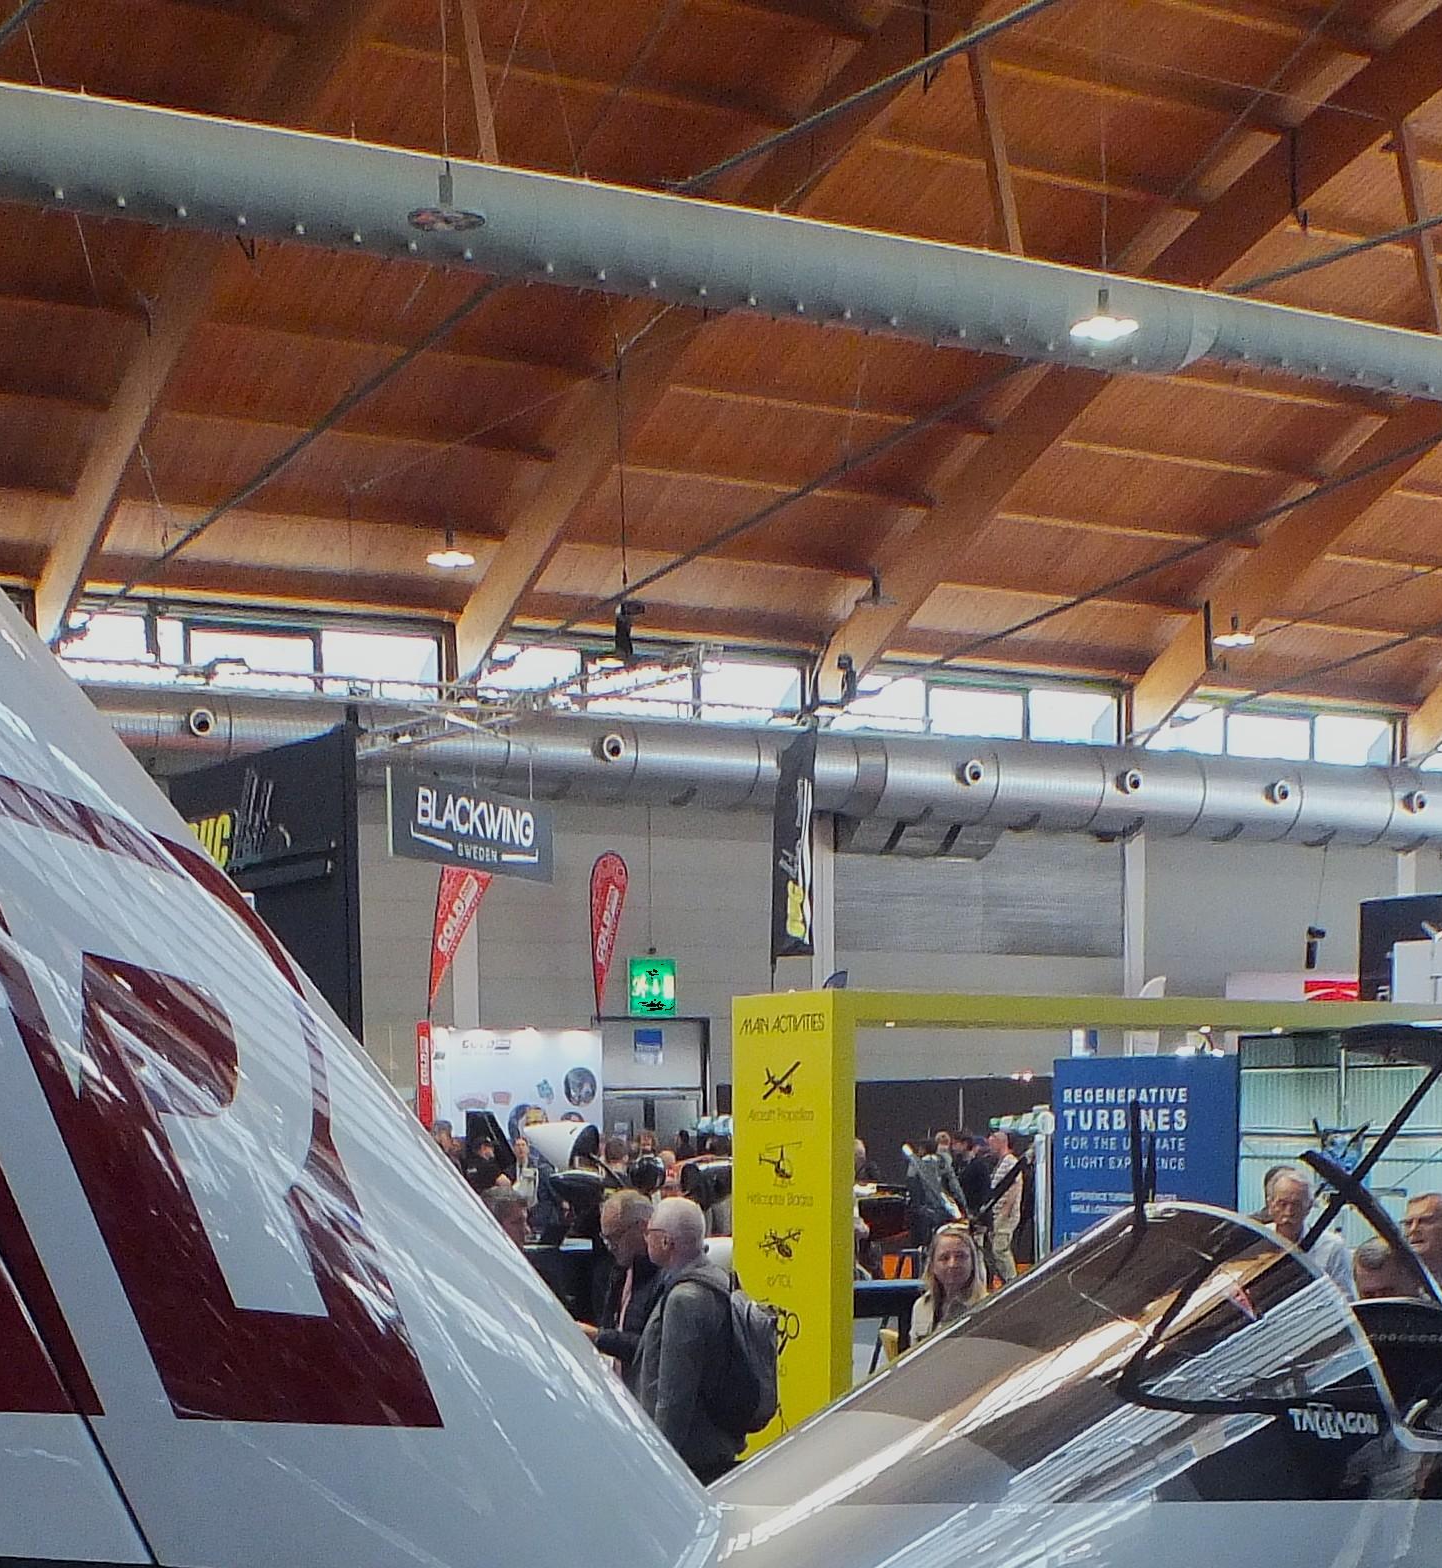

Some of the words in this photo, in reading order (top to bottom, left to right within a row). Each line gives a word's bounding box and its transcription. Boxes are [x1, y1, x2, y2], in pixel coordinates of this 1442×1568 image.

[417, 786, 535, 847] BLACKWING
[189, 812, 232, 869] UC
[457, 842, 499, 864] SWEDEN
[739, 1016, 770, 1036] MAIN
[771, 1013, 825, 1034] ACTIVITIES
[1063, 1087, 1188, 1104] REGENERATIVE
[1063, 1108, 1188, 1132] TURBNES
[1063, 1136, 1089, 1150] FOR
[1093, 1136, 1117, 1150] THE
[1122, 1136, 1187, 1152] UATE
[1063, 1155, 1104, 1170] FLIGHT
[1108, 1156, 1186, 1171] EXPNCE
